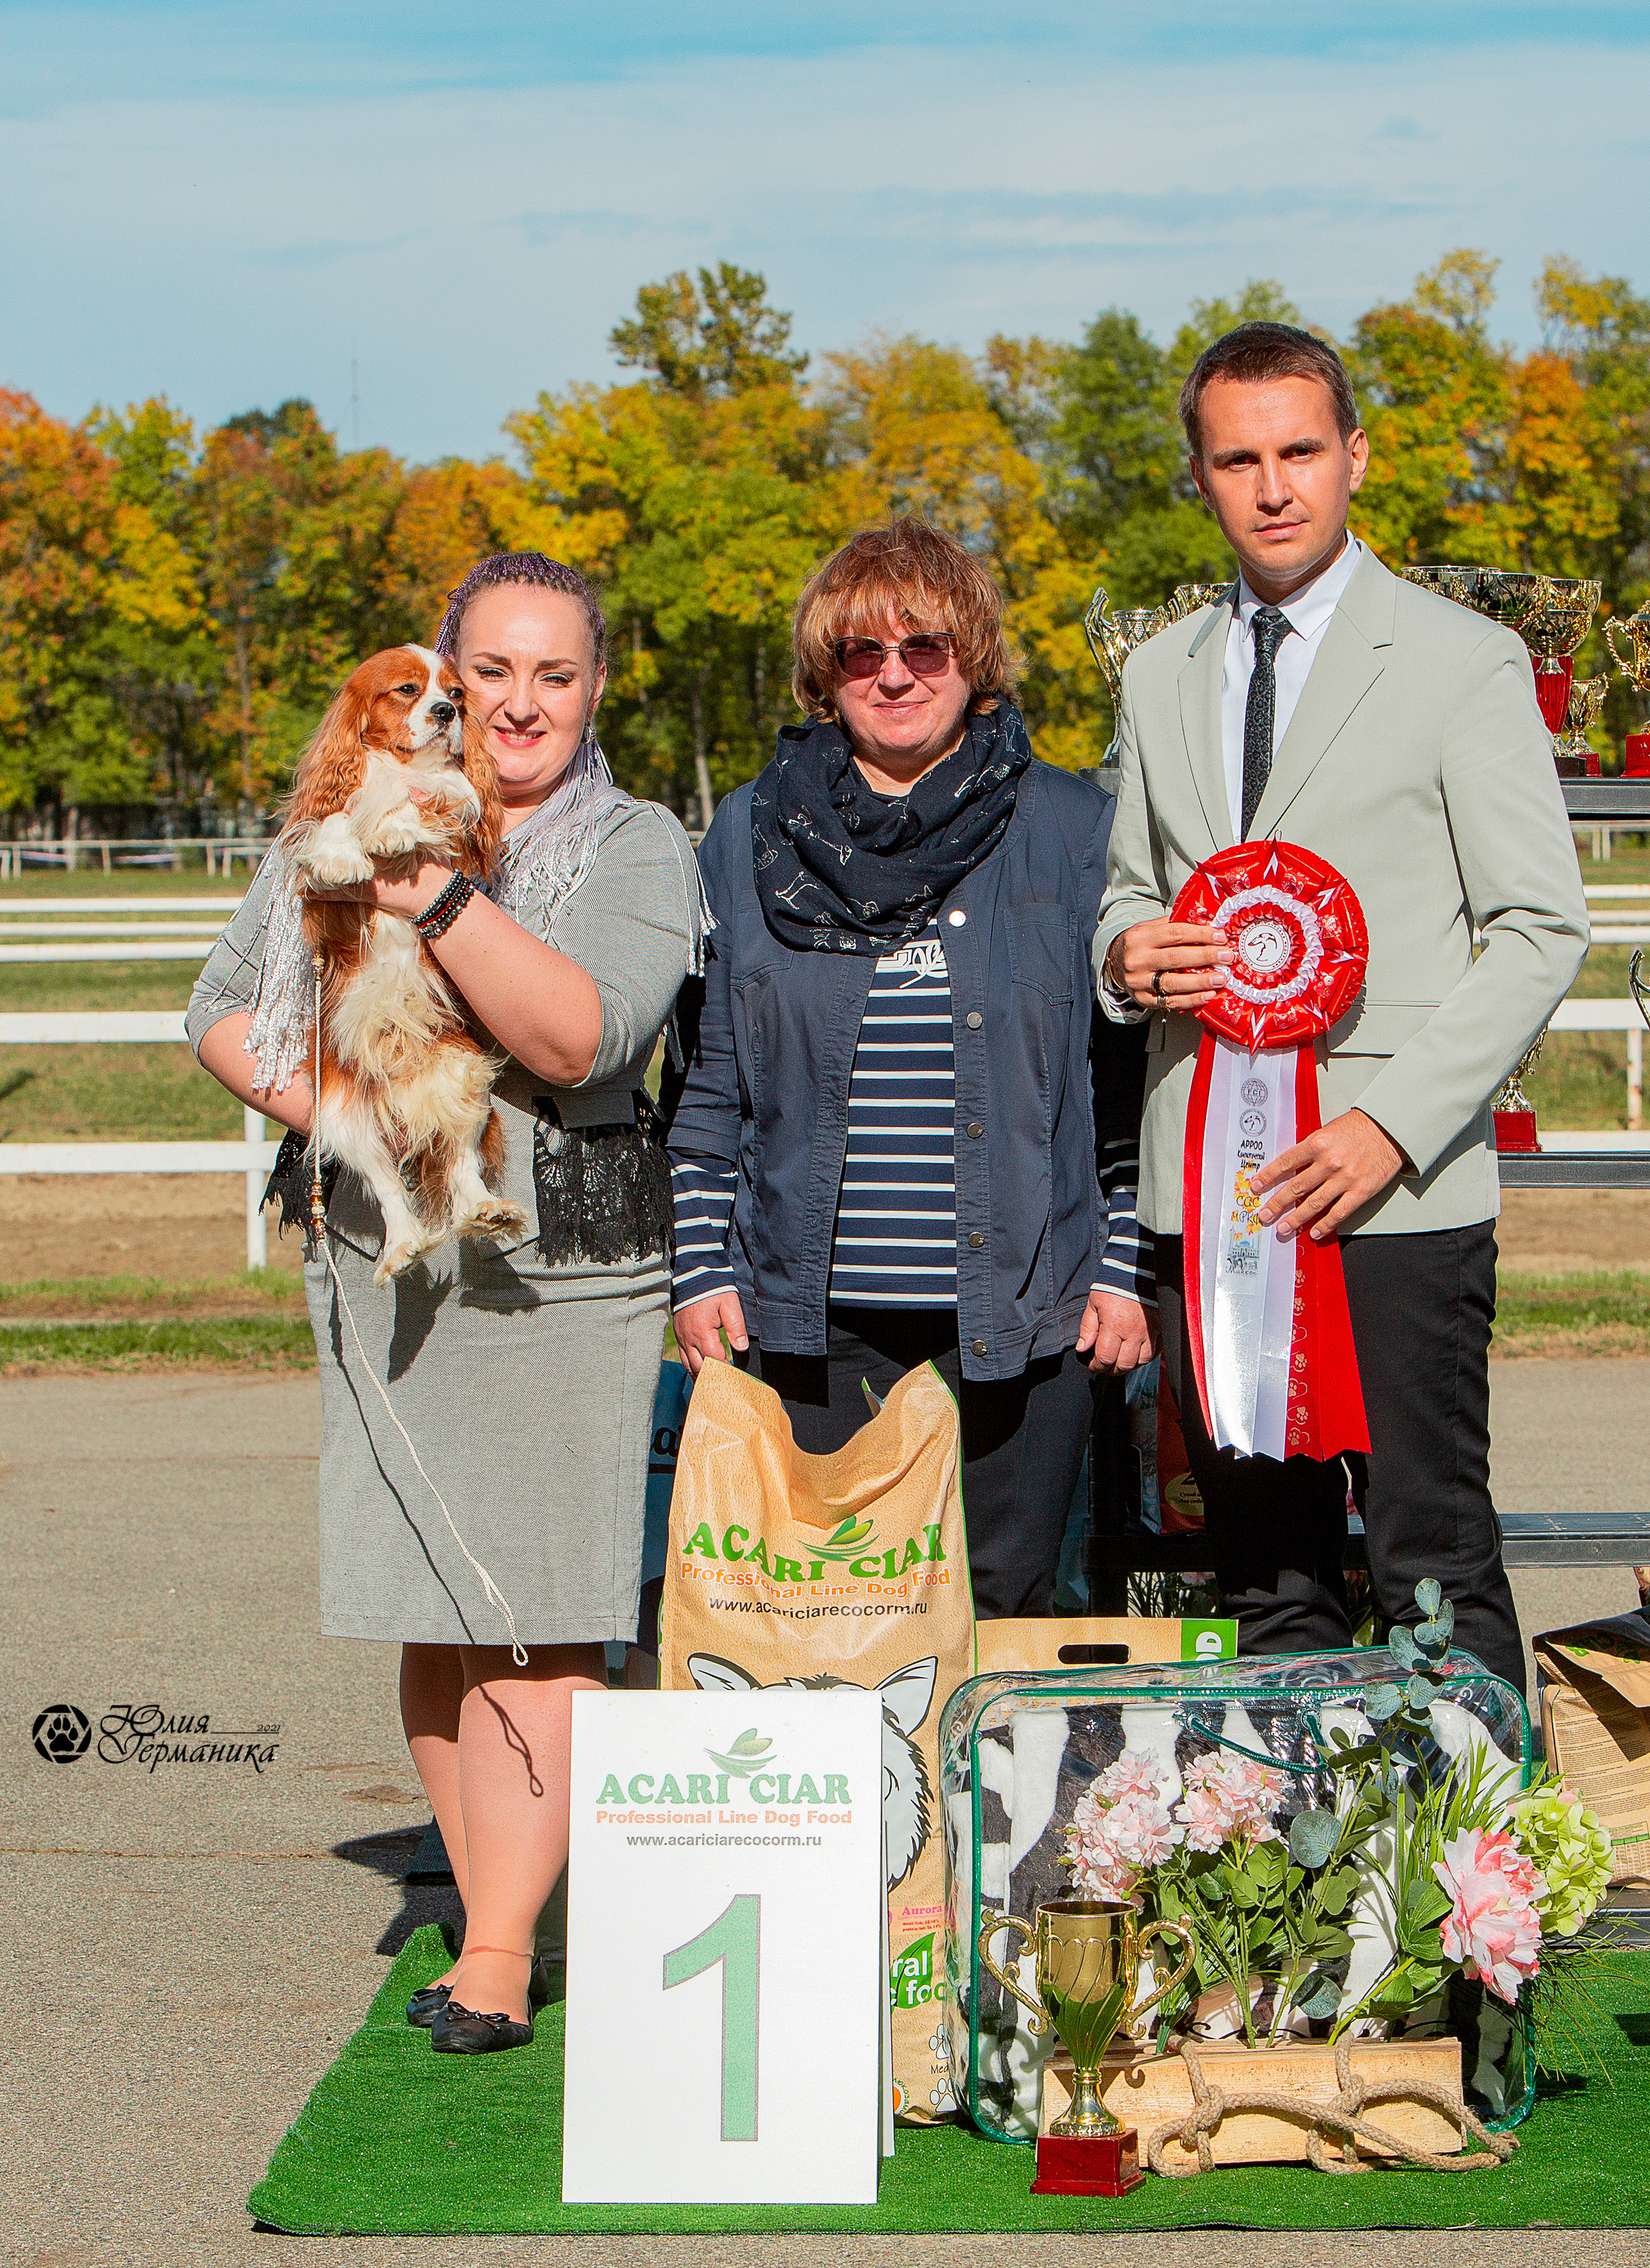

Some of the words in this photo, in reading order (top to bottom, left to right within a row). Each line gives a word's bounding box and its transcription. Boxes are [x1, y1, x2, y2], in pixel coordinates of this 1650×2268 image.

[682, 1522, 826, 1583] ACARI
[848, 1523, 947, 1578] CIAR
[680, 1561, 802, 1599] Professional
[810, 1583, 859, 1596] Line
[866, 1582, 909, 1598] Dog
[912, 1569, 951, 1588] Food
[709, 1598, 928, 1620] www.acariciarecocorm.ru
[596, 1774, 732, 1804] ACARI
[749, 1774, 852, 1804] CIAR
[596, 1810, 712, 1824] Professional
[719, 1810, 759, 1824] Line
[765, 1810, 801, 1827] Dog
[808, 1810, 852, 1824] Food
[626, 1833, 822, 1846] www.acariciarecocorm.ru
[902, 1906, 942, 1915] Aurora
[893, 1951, 927, 1977] ral
[906, 1979, 946, 2005] foo
[663, 1894, 761, 2142] 1
[931, 2062, 949, 2075] Med
